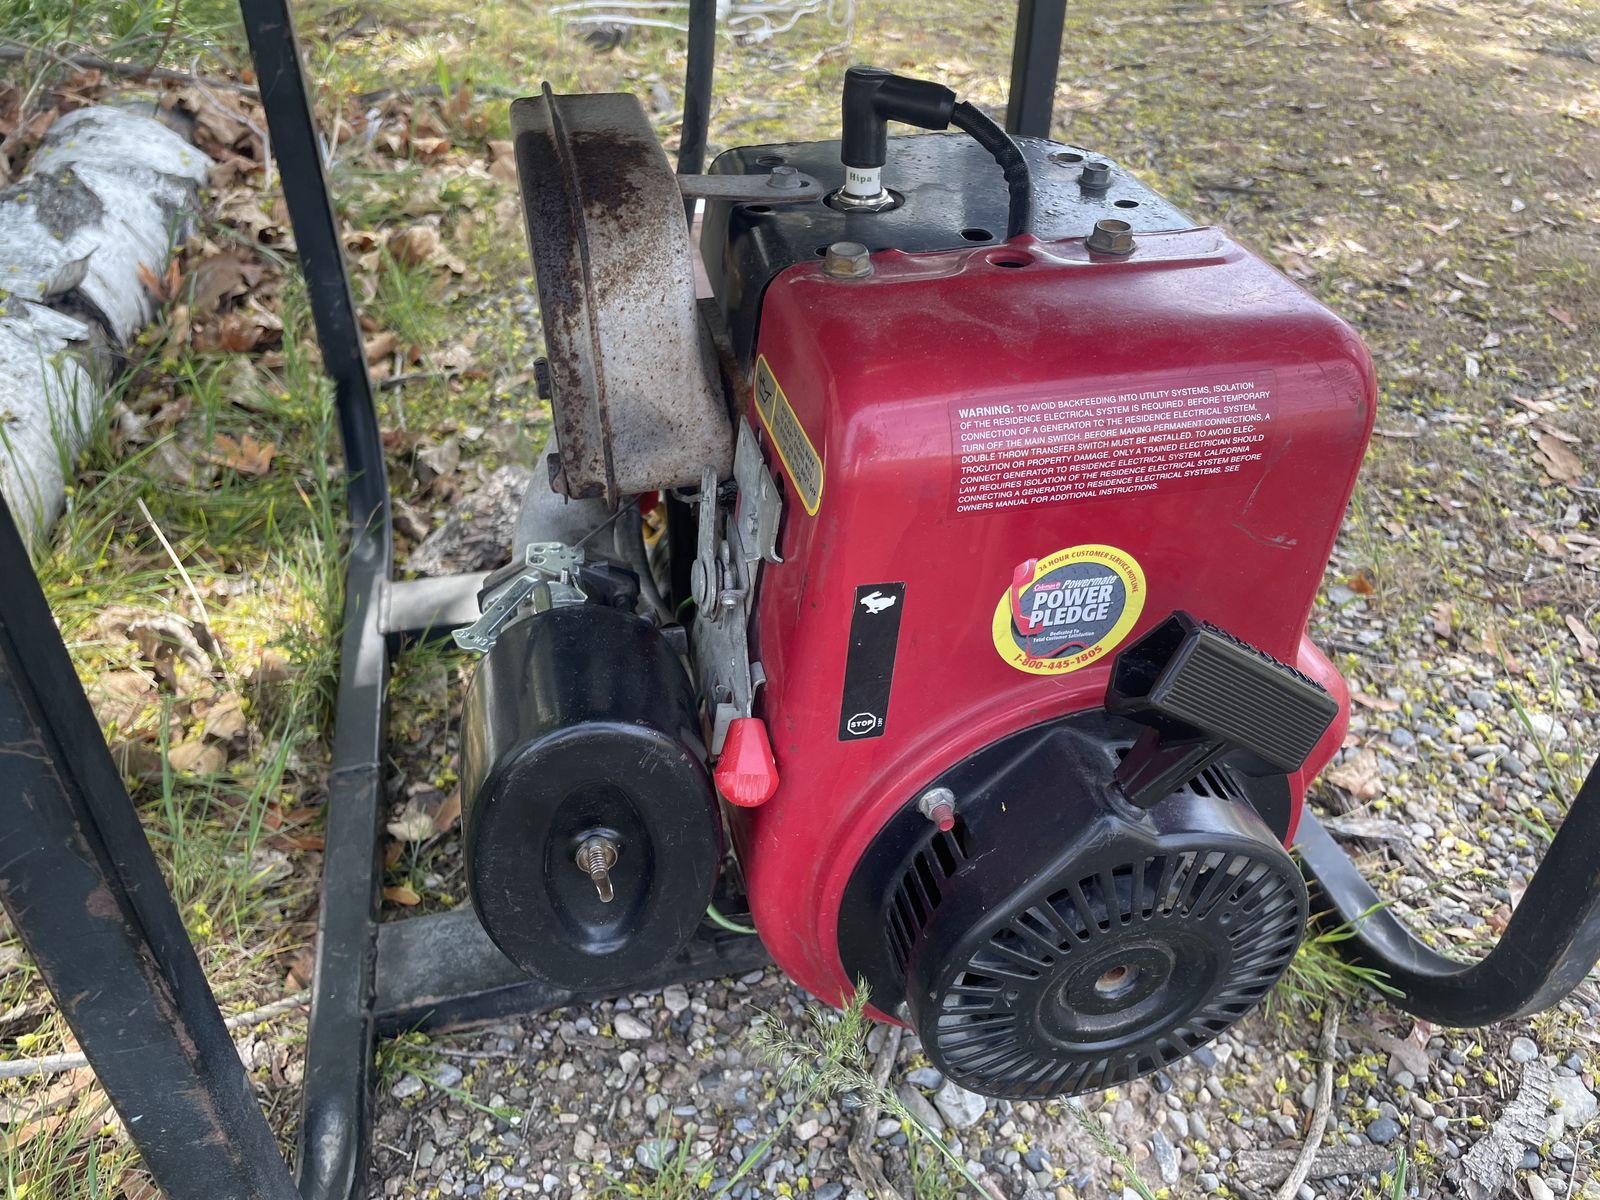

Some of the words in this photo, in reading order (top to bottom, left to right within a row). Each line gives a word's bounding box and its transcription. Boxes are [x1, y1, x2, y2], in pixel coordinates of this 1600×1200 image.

[850, 172, 872, 184] Hipa
[959, 405, 1013, 418] WARNING:
[1031, 402, 1055, 411] AVOID
[1059, 396, 1116, 408] BACKFEEDING
[1119, 394, 1137, 402] INTO
[1140, 390, 1169, 400] UTILITY
[1214, 382, 1254, 393] ISOLATION
[974, 420, 990, 428] THE
[994, 414, 1041, 426] RESIDENCE
[1044, 409, 1094, 421] ELECTRICAL
[1096, 405, 1129, 415] SYSTEM
[1188, 396, 1219, 406] BEFORE
[1222, 391, 1270, 402] TEMPORARY
[961, 428, 1016, 441] CONNECTION
[1041, 420, 1090, 432] GENERATOR
[1108, 417, 1122, 425] THE
[1125, 412, 1170, 424] RESIDENCE
[1174, 407, 1221, 418] ELECTRICAL
[962, 443, 984, 452] TURN
[987, 441, 1003, 449] OFF
[1006, 439, 1022, 447] THE
[1025, 436, 1045, 445] MAIN
[1085, 429, 1117, 439] BEFORE
[1120, 425, 1151, 435] MAKING
[1154, 419, 1202, 431] PERMANENT
[962, 453, 995, 463] DOUBLE
[998, 449, 1032, 459] THROW
[1031, 444, 1074, 455] TRANSFER
[1078, 440, 1108, 450] SWITCH
[1111, 438, 1133, 447] MUST
[1207, 427, 1231, 436] AVOID
[1234, 424, 1256, 433] ELEC-
[962, 461, 1010, 473] TROCUTION
[1027, 455, 1071, 466] PROPERTY
[1113, 448, 1134, 457] ONLY
[1143, 443, 1177, 453] TRAINED
[1180, 437, 1230, 449] ELECTRICIAN
[1232, 434, 1264, 444] SHOULD
[960, 485, 977, 493] LAW
[979, 480, 1021, 491] REQUIRES
[1024, 475, 1066, 486] ISOLATION
[1082, 471, 1097, 479] THE
[1100, 466, 1145, 477] RESIDENCE
[1148, 460, 1194, 472] ELECTRICAL
[1198, 456, 1228, 466] SYSTEM
[1231, 452, 1262, 462] BEFORE
[961, 473, 1000, 484] CONNECT
[1003, 467, 1053, 479] GENERATOR
[1070, 460, 1116, 472] RESIDENCE
[1118, 454, 1166, 466] ELECTRICAL
[1205, 445, 1249, 456] CALIFORNIA
[958, 490, 1012, 503] CONNECTING
[1022, 483, 1071, 495] GENERATOR
[1087, 476, 1132, 488] RESIDENCE
[1135, 470, 1181, 482] ELECTRICAL
[1224, 463, 1240, 472] SEE
[957, 501, 993, 512] OWNERS
[996, 497, 1028, 507] MANUAL
[1031, 495, 1048, 503] FOR
[1050, 490, 1096, 501] ADDITIONAL
[1048, 554, 1070, 566] HOUR
[1072, 550, 1109, 559] CUSTOMER
[1108, 554, 1130, 571] SERVICE
[1127, 569, 1139, 592] HOTLINE
[1062, 575, 1118, 589] Powermate
[1032, 585, 1113, 610] POWER
[1029, 603, 1109, 628] PLEDGE
[1014, 646, 1102, 670] 1-800-445-1805
